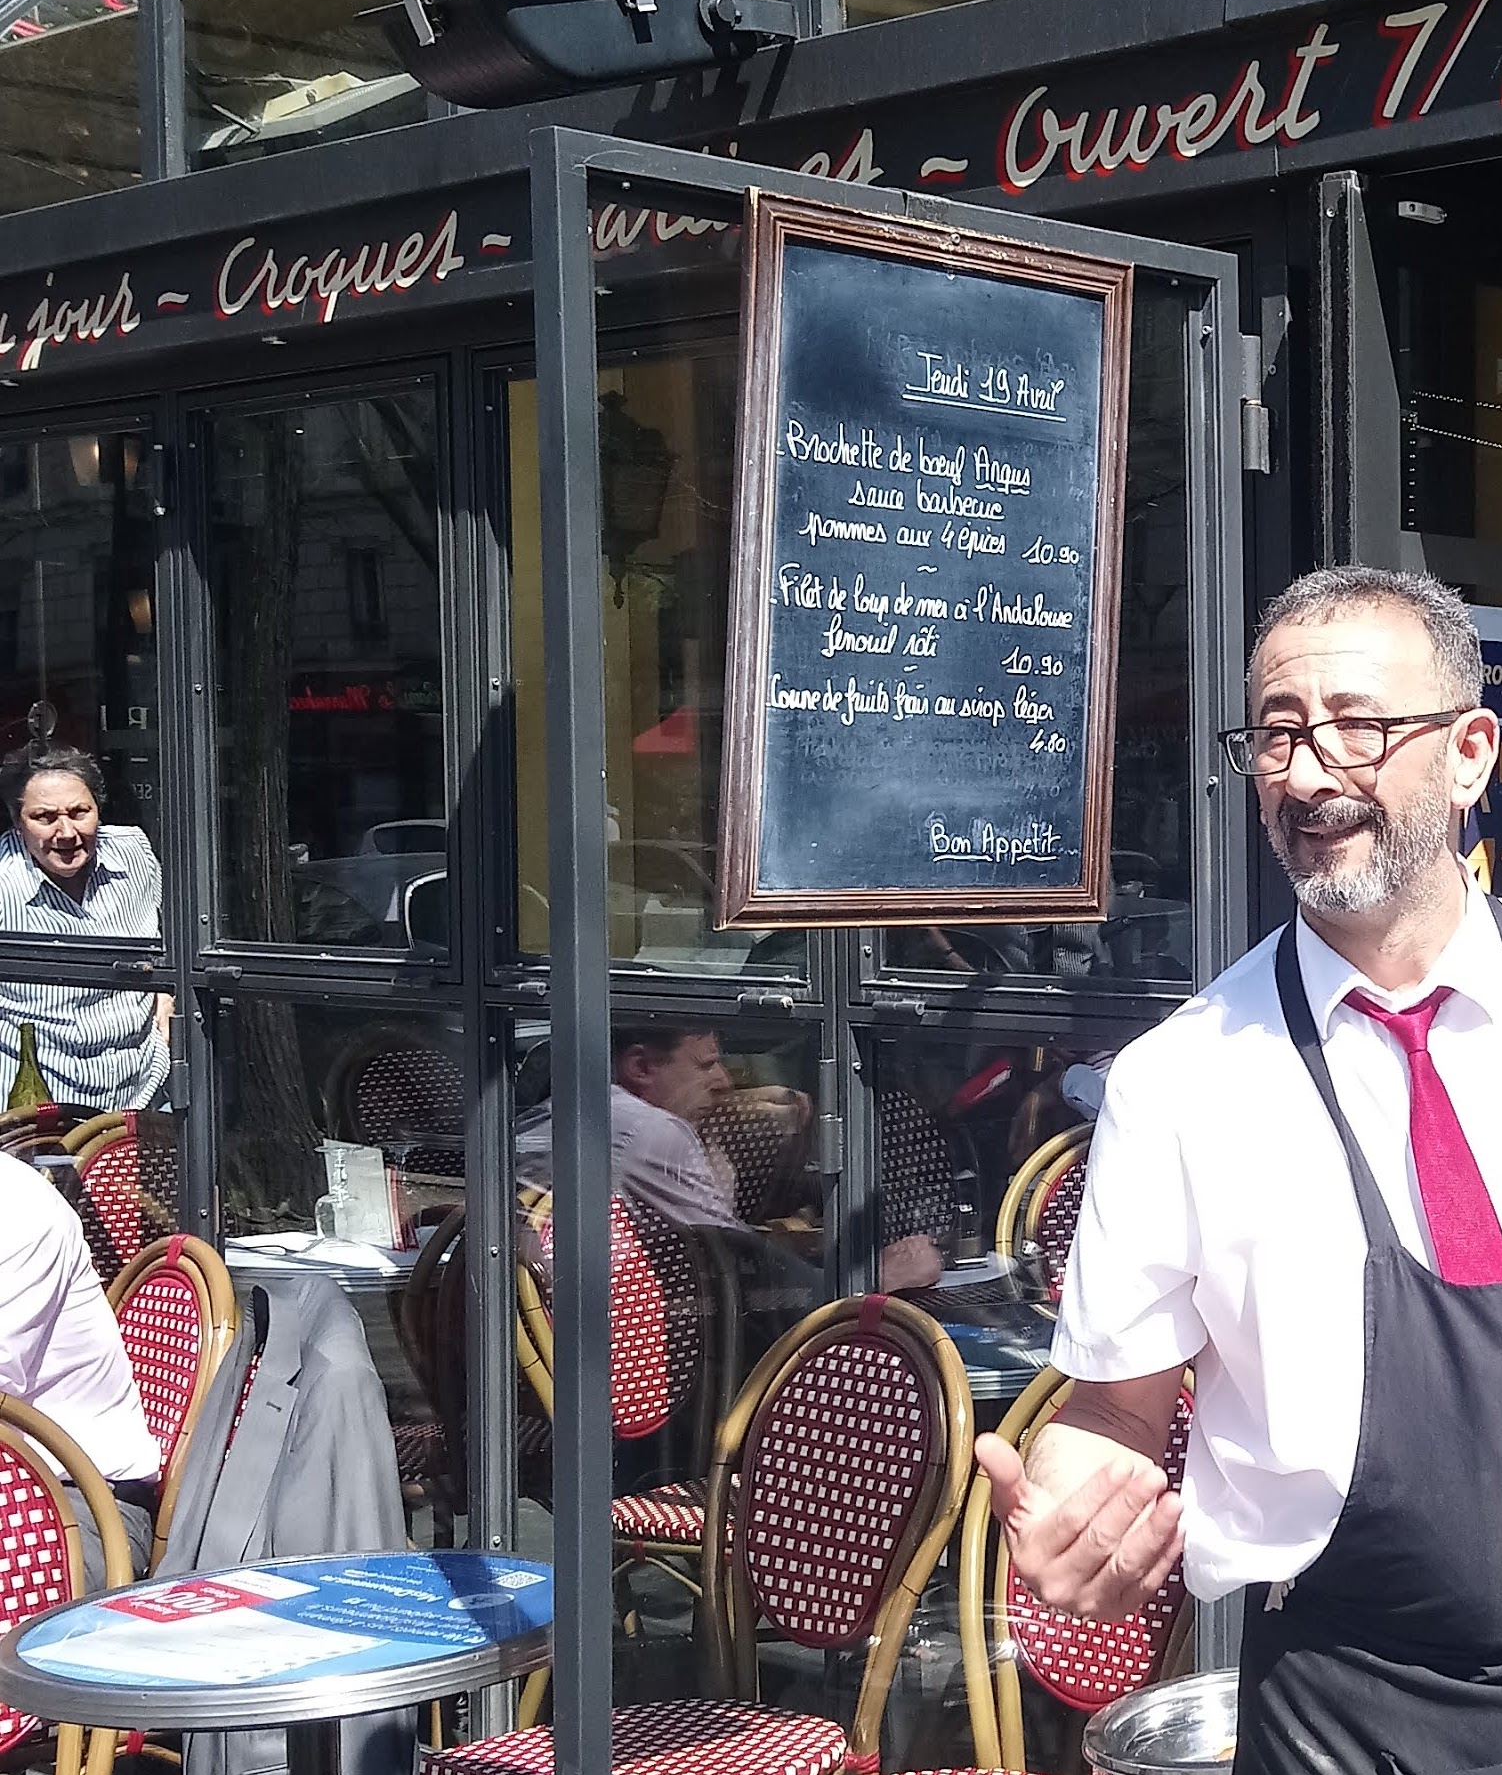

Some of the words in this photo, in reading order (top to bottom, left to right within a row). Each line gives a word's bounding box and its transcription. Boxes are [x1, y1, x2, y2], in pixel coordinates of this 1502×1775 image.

[21, 272, 140, 370] jour
[219, 210, 463, 322] Croques
[1004, 22, 1340, 190] Ouvert
[905, 351, 969, 399] Jeudi
[978, 366, 1011, 404] 19
[1016, 374, 1065, 412] Avril
[786, 419, 883, 468] Brochette
[889, 434, 914, 473] de
[973, 445, 1031, 493] Angus
[848, 479, 905, 511] sauce
[916, 478, 1005, 520] barbecue
[798, 511, 887, 546] pommes
[896, 526, 932, 547] aux
[940, 520, 955, 550] 4
[1021, 536, 1080, 565] 10.90
[778, 561, 824, 609] Filet
[828, 576, 847, 611] de
[893, 581, 914, 616] de
[1001, 646, 1064, 676] 10.90
[822, 678, 843, 712] de
[1029, 728, 1066, 754] 4.80
[931, 823, 971, 854] Bon
